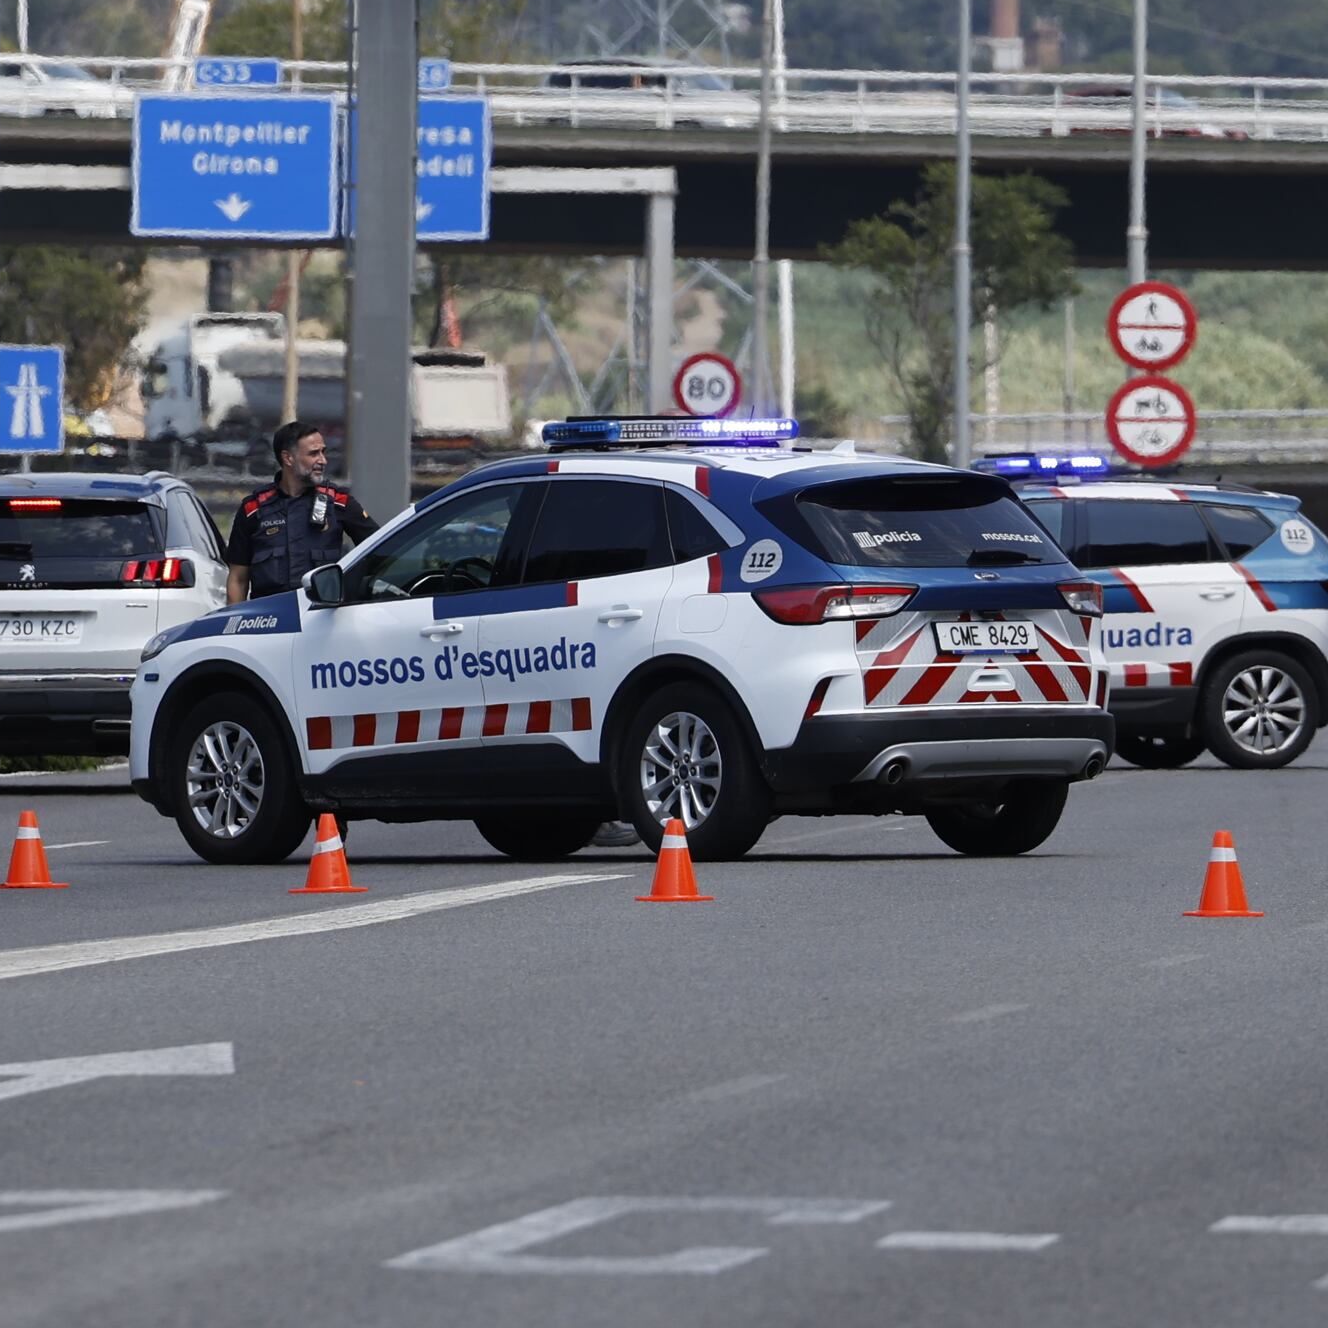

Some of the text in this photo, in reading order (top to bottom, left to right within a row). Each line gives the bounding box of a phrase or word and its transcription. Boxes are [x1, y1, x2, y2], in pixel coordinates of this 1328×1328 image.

[159, 120, 312, 147] Montpellier
[417, 127, 472, 145] resa
[191, 153, 279, 176] Girona
[688, 376, 726, 401] 80
[874, 530, 923, 546] policia
[981, 531, 1044, 544] mossos.cat
[749, 552, 776, 568] 112
[40, 620, 76, 636] KZC
[237, 615, 278, 633] policia
[950, 625, 1029, 647] CME 8429
[1101, 622, 1192, 653] uadra
[311, 656, 425, 689] mossos
